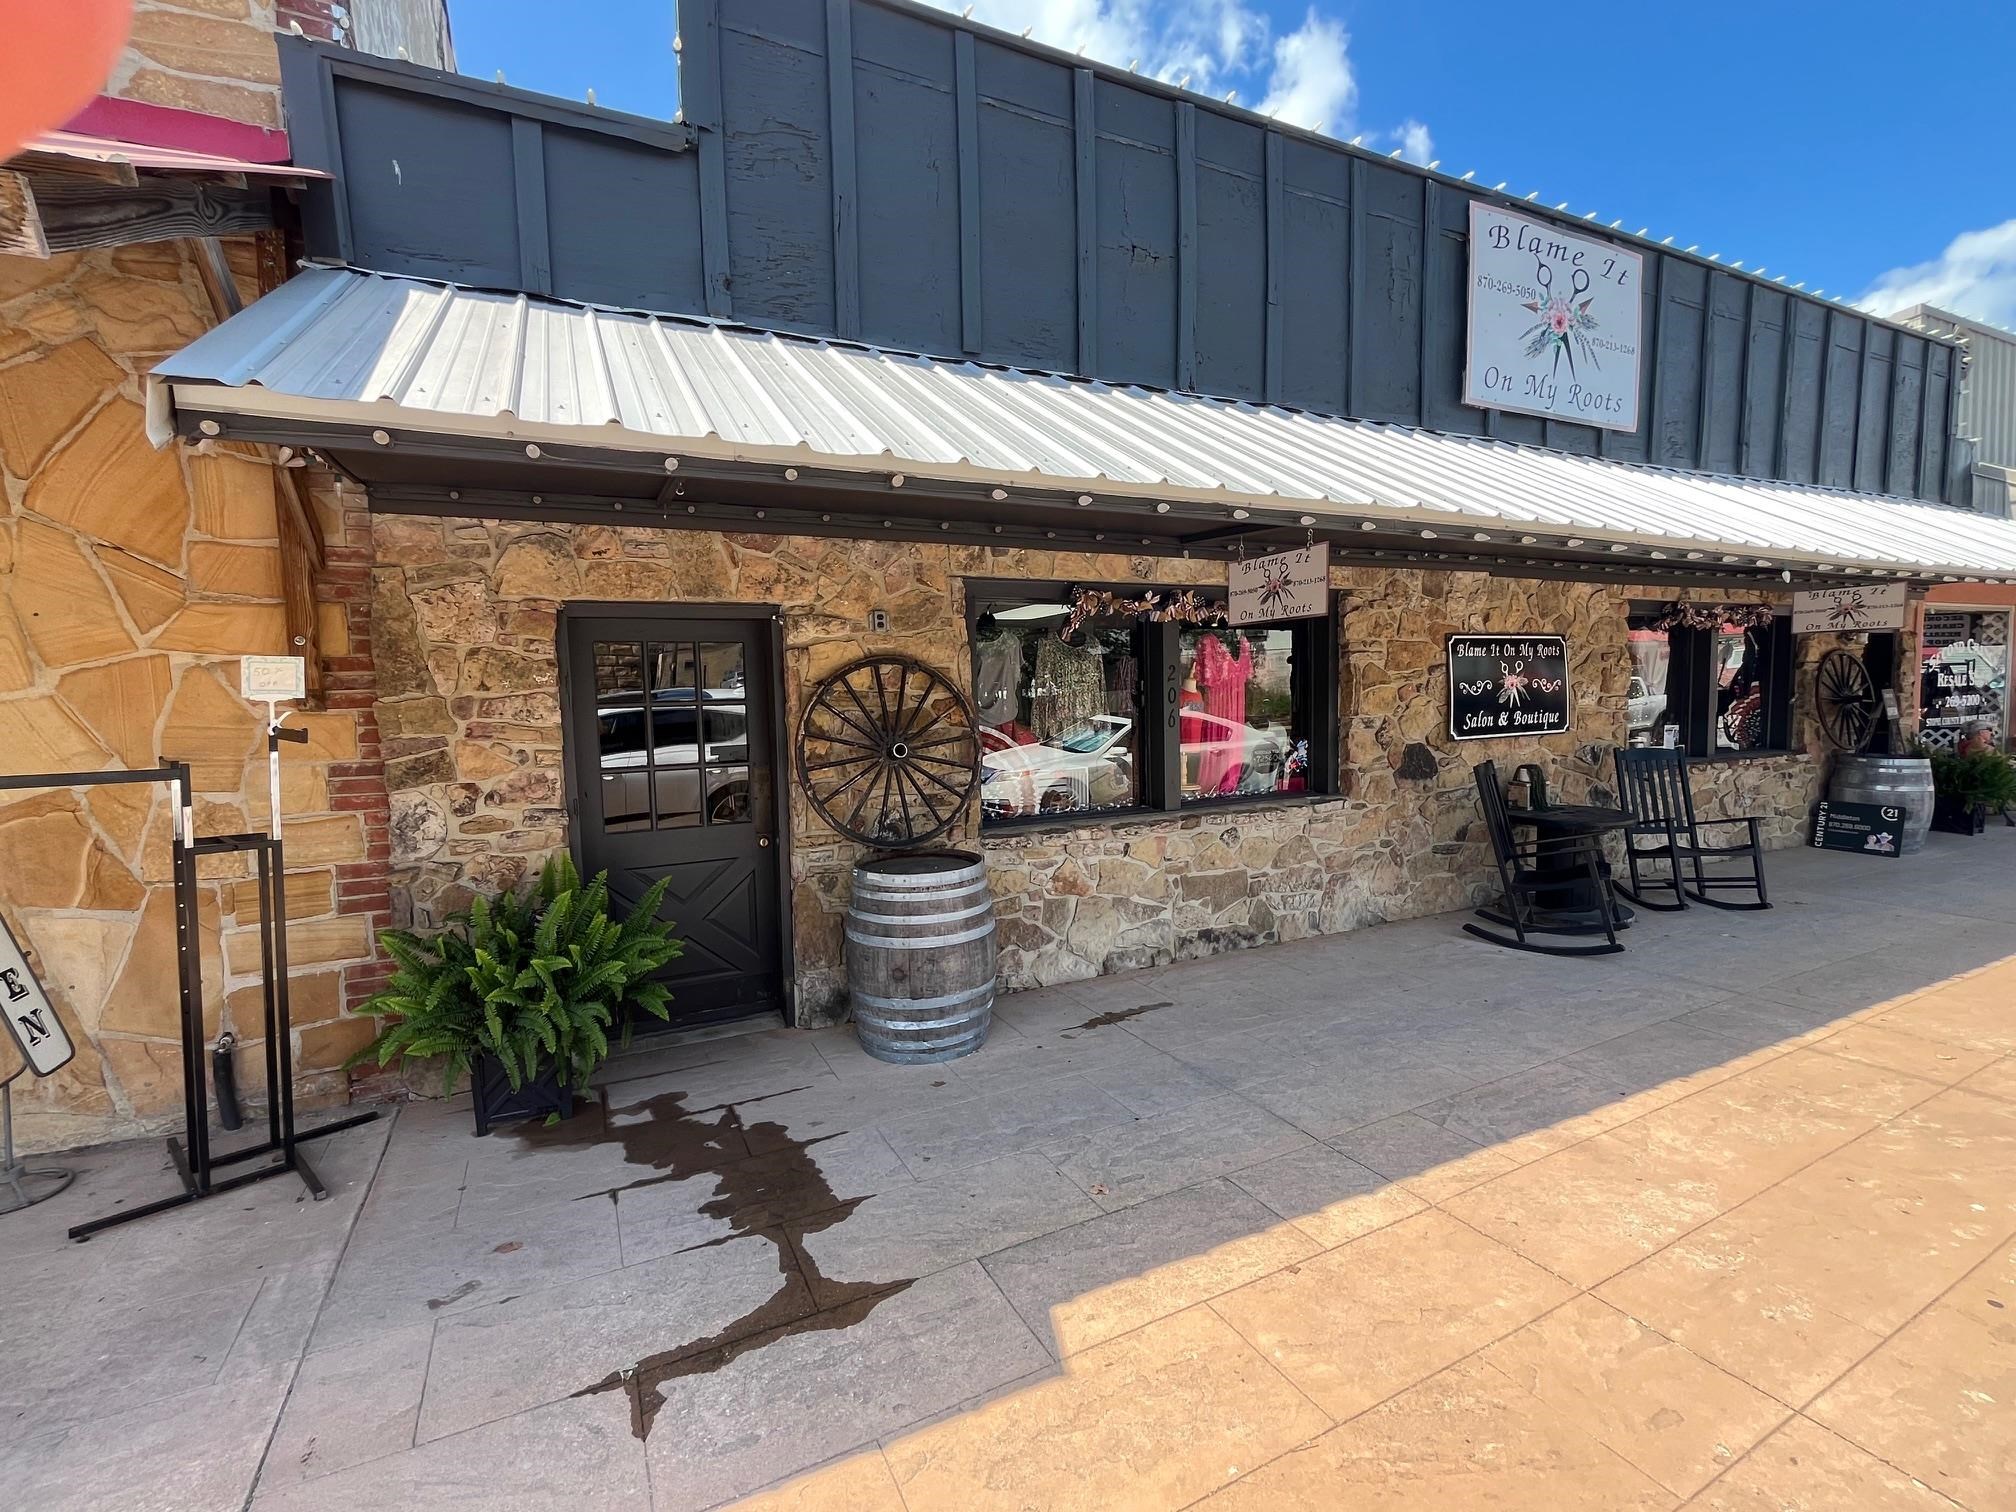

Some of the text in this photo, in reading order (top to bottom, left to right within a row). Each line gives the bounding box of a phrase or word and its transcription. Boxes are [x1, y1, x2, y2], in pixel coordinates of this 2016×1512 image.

[1488, 224, 1630, 286] Blame It
[1476, 276, 1537, 300] 870-269-5050
[1484, 366, 1623, 413] On My Roots
[1242, 552, 1312, 575] Blame It
[1808, 590, 1860, 600] Blame
[1240, 603, 1313, 621] On My Roots
[1805, 620, 1888, 631] On My Roots
[1457, 642, 1560, 662] Blame It On My Roots
[1168, 664, 1177, 728] 206
[1463, 710, 1560, 730] Salon & Boutique
[1814, 801, 1829, 847] CENTURY 21
